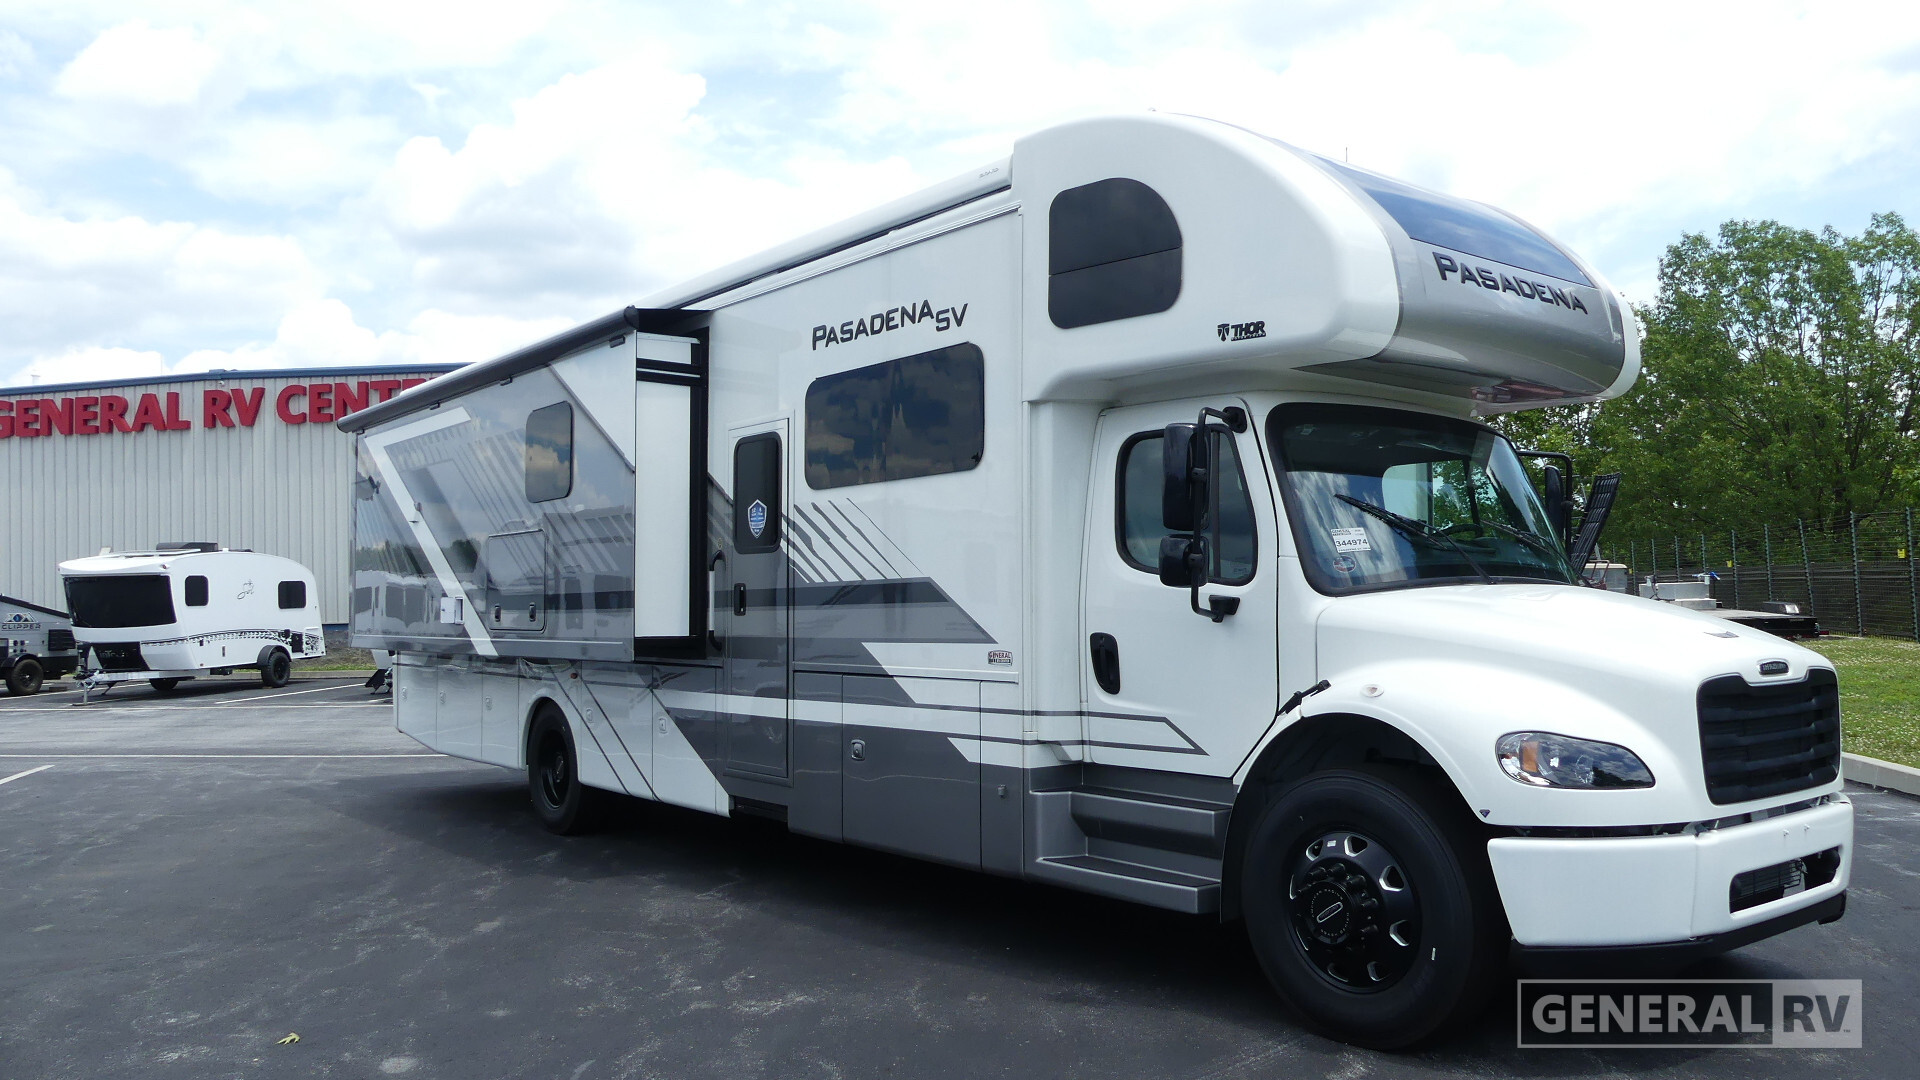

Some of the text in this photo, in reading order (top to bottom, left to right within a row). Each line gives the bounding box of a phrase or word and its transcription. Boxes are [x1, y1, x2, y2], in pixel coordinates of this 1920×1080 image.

[1432, 251, 1589, 315] PASADENA
[812, 299, 969, 351] PASADENA SV
[1230, 320, 1266, 337] THOR
[203, 387, 266, 429] RV
[276, 377, 440, 425] CENT
[1335, 538, 1368, 547] 344974
